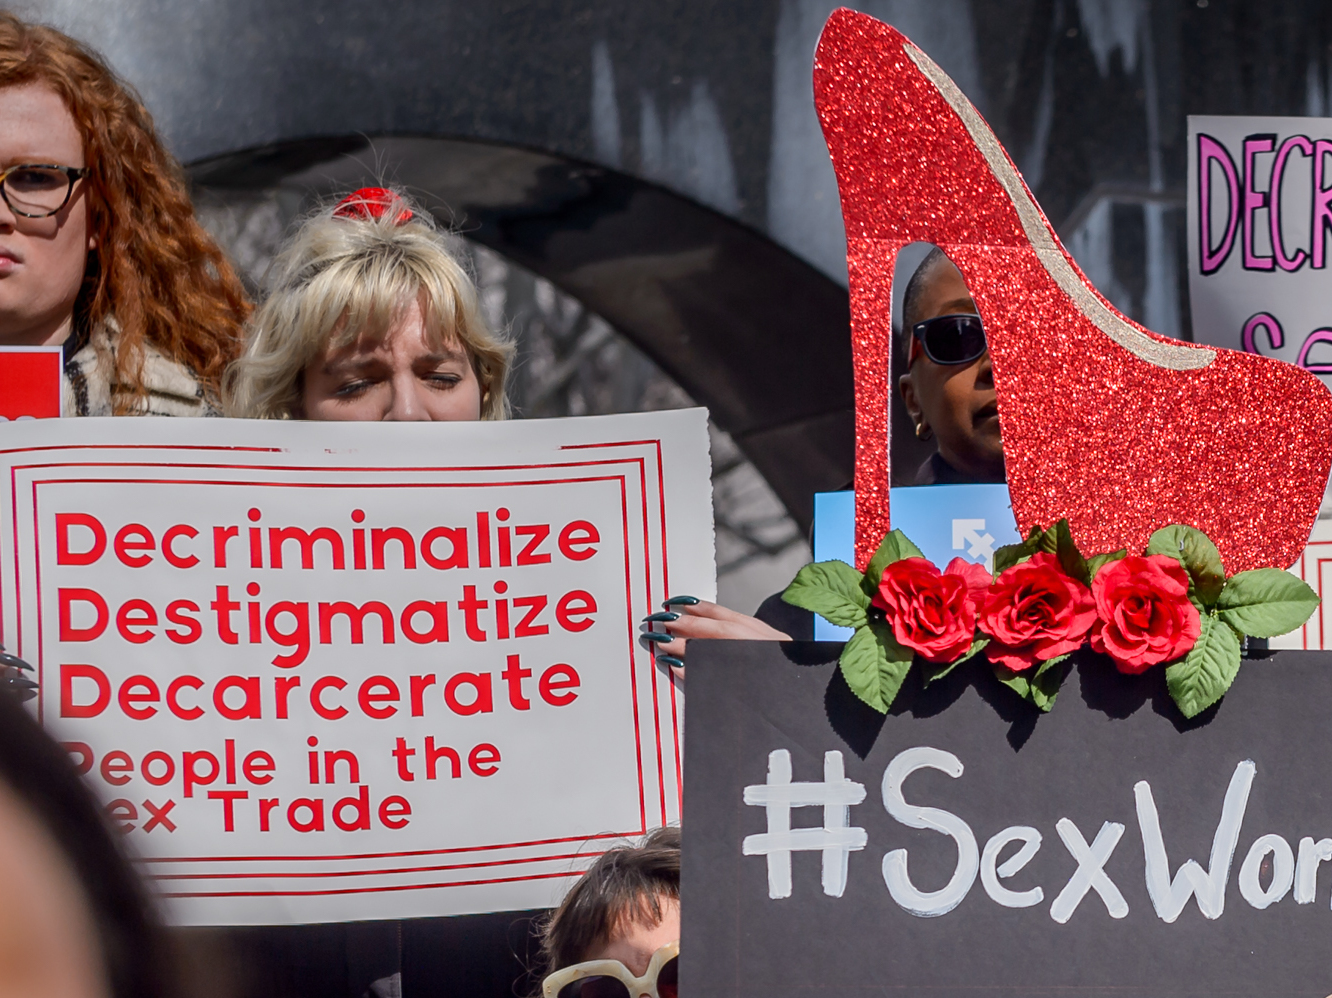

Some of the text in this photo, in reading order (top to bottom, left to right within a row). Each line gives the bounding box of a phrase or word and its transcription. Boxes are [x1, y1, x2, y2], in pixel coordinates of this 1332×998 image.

[55, 507, 602, 571] Decriminalize
[58, 580, 598, 668] Destigmatize
[59, 653, 581, 721] Decarcerate
[306, 736, 360, 786] in
[392, 734, 502, 782] the
[104, 785, 413, 835] ex Trade
